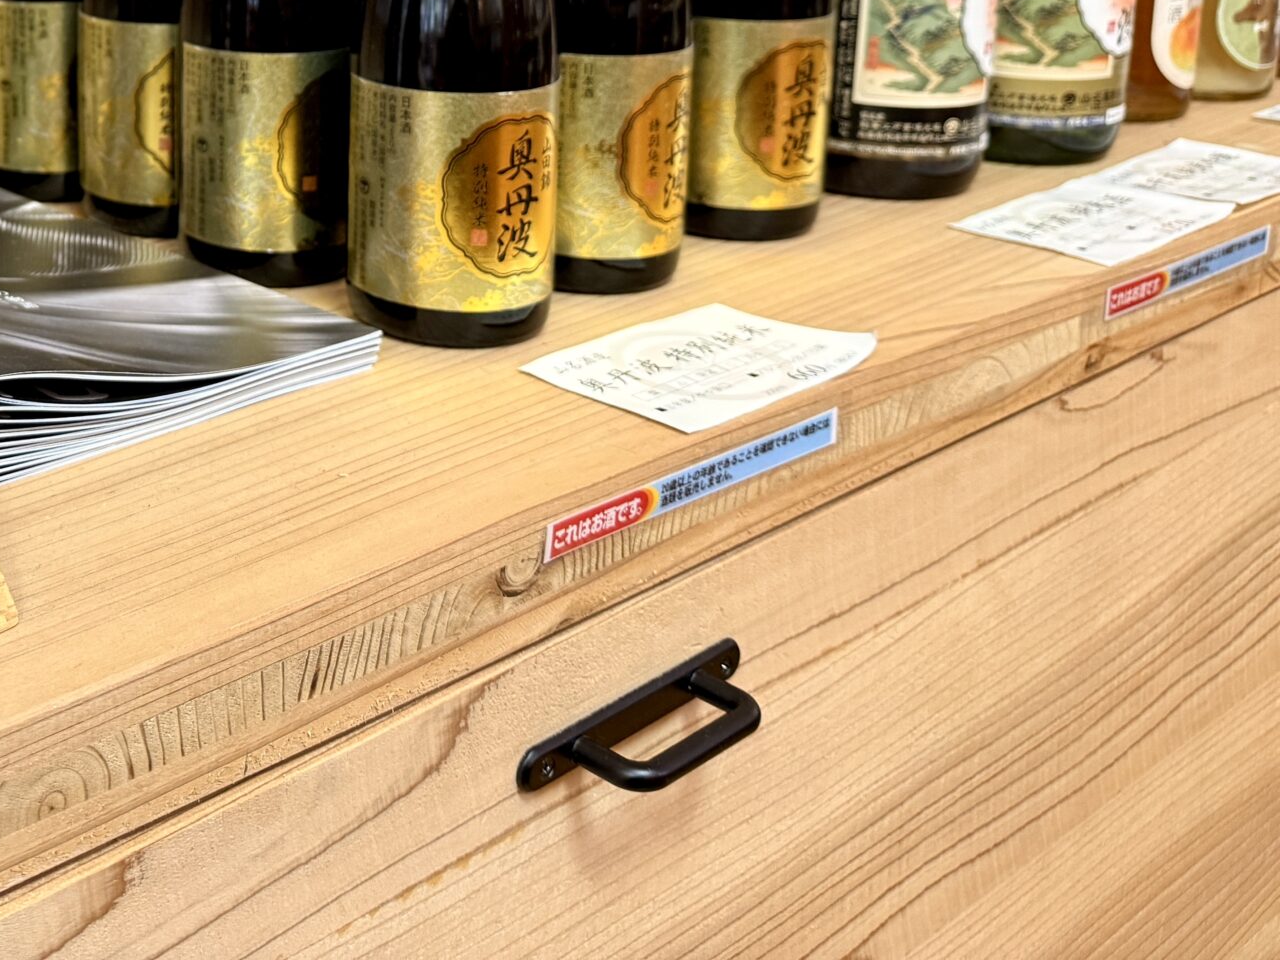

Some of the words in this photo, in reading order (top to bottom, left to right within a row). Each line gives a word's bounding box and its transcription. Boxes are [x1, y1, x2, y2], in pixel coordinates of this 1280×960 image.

[496, 129, 539, 263] 奥丹波
[553, 496, 643, 550] これはお酒です。
